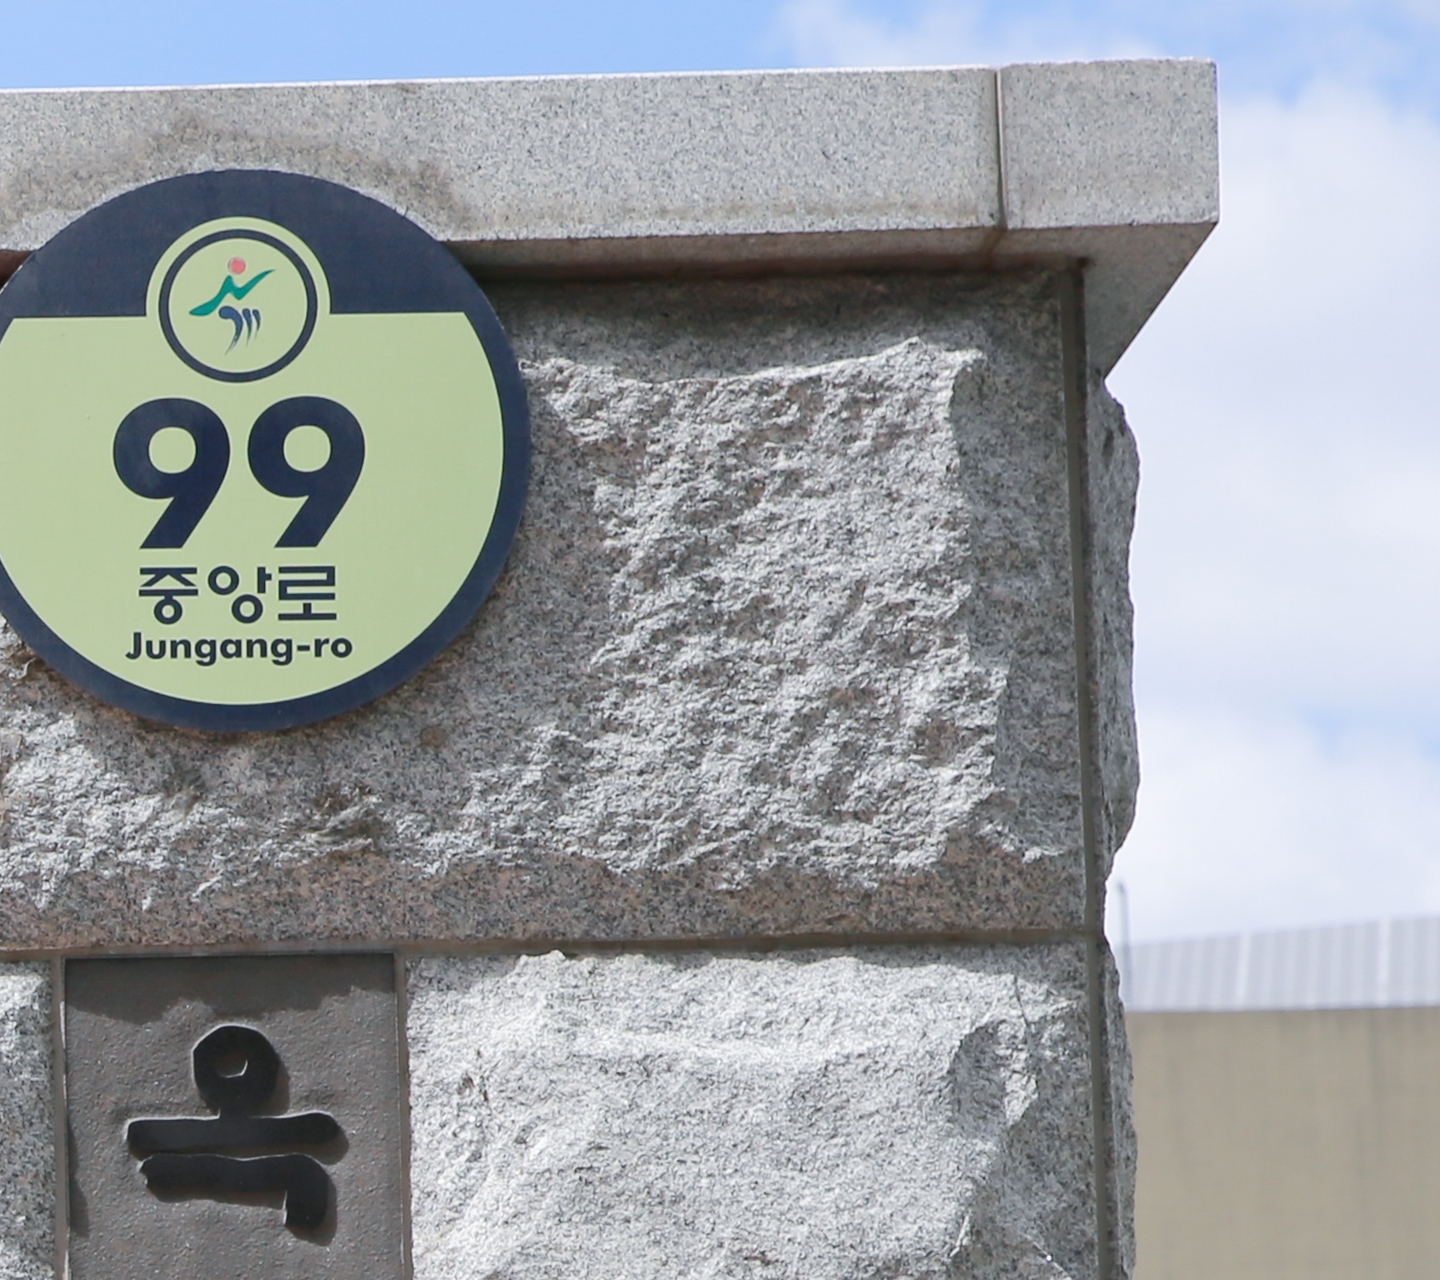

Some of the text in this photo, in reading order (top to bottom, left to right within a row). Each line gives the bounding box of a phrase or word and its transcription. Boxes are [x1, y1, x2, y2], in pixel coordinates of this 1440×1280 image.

[111, 395, 367, 550] 99
[137, 565, 338, 625] 중앙로
[124, 631, 354, 667] Jungang-ro
